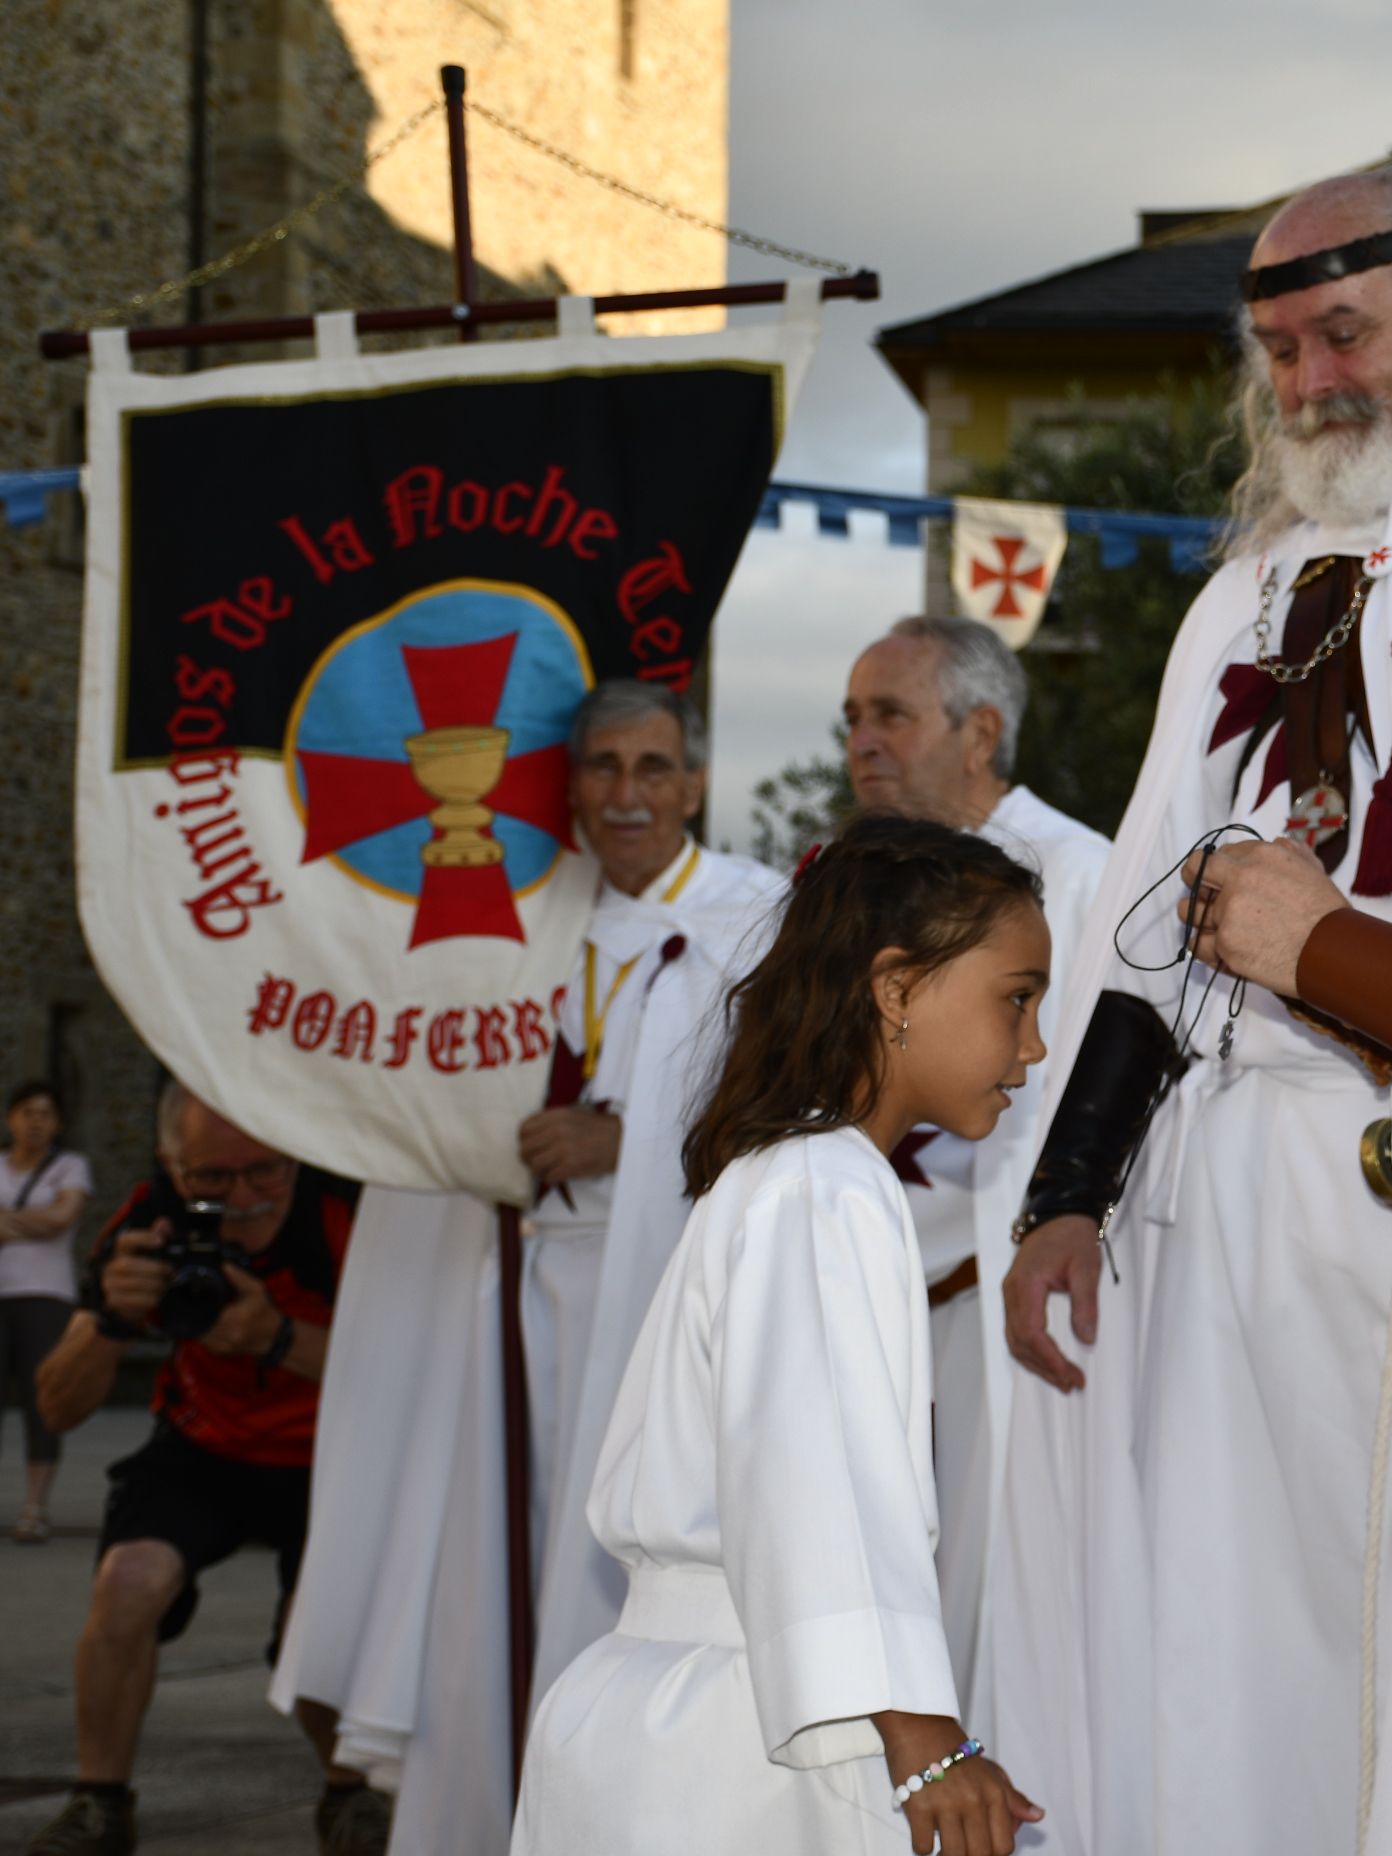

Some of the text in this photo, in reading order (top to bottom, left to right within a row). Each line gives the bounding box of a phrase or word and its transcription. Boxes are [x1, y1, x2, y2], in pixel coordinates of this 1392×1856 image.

[278, 515, 376, 585] la
[382, 464, 619, 561] Noche
[181, 574, 294, 653] de
[154, 654, 285, 942] Amigos
[246, 972, 568, 1075] PONFERR
